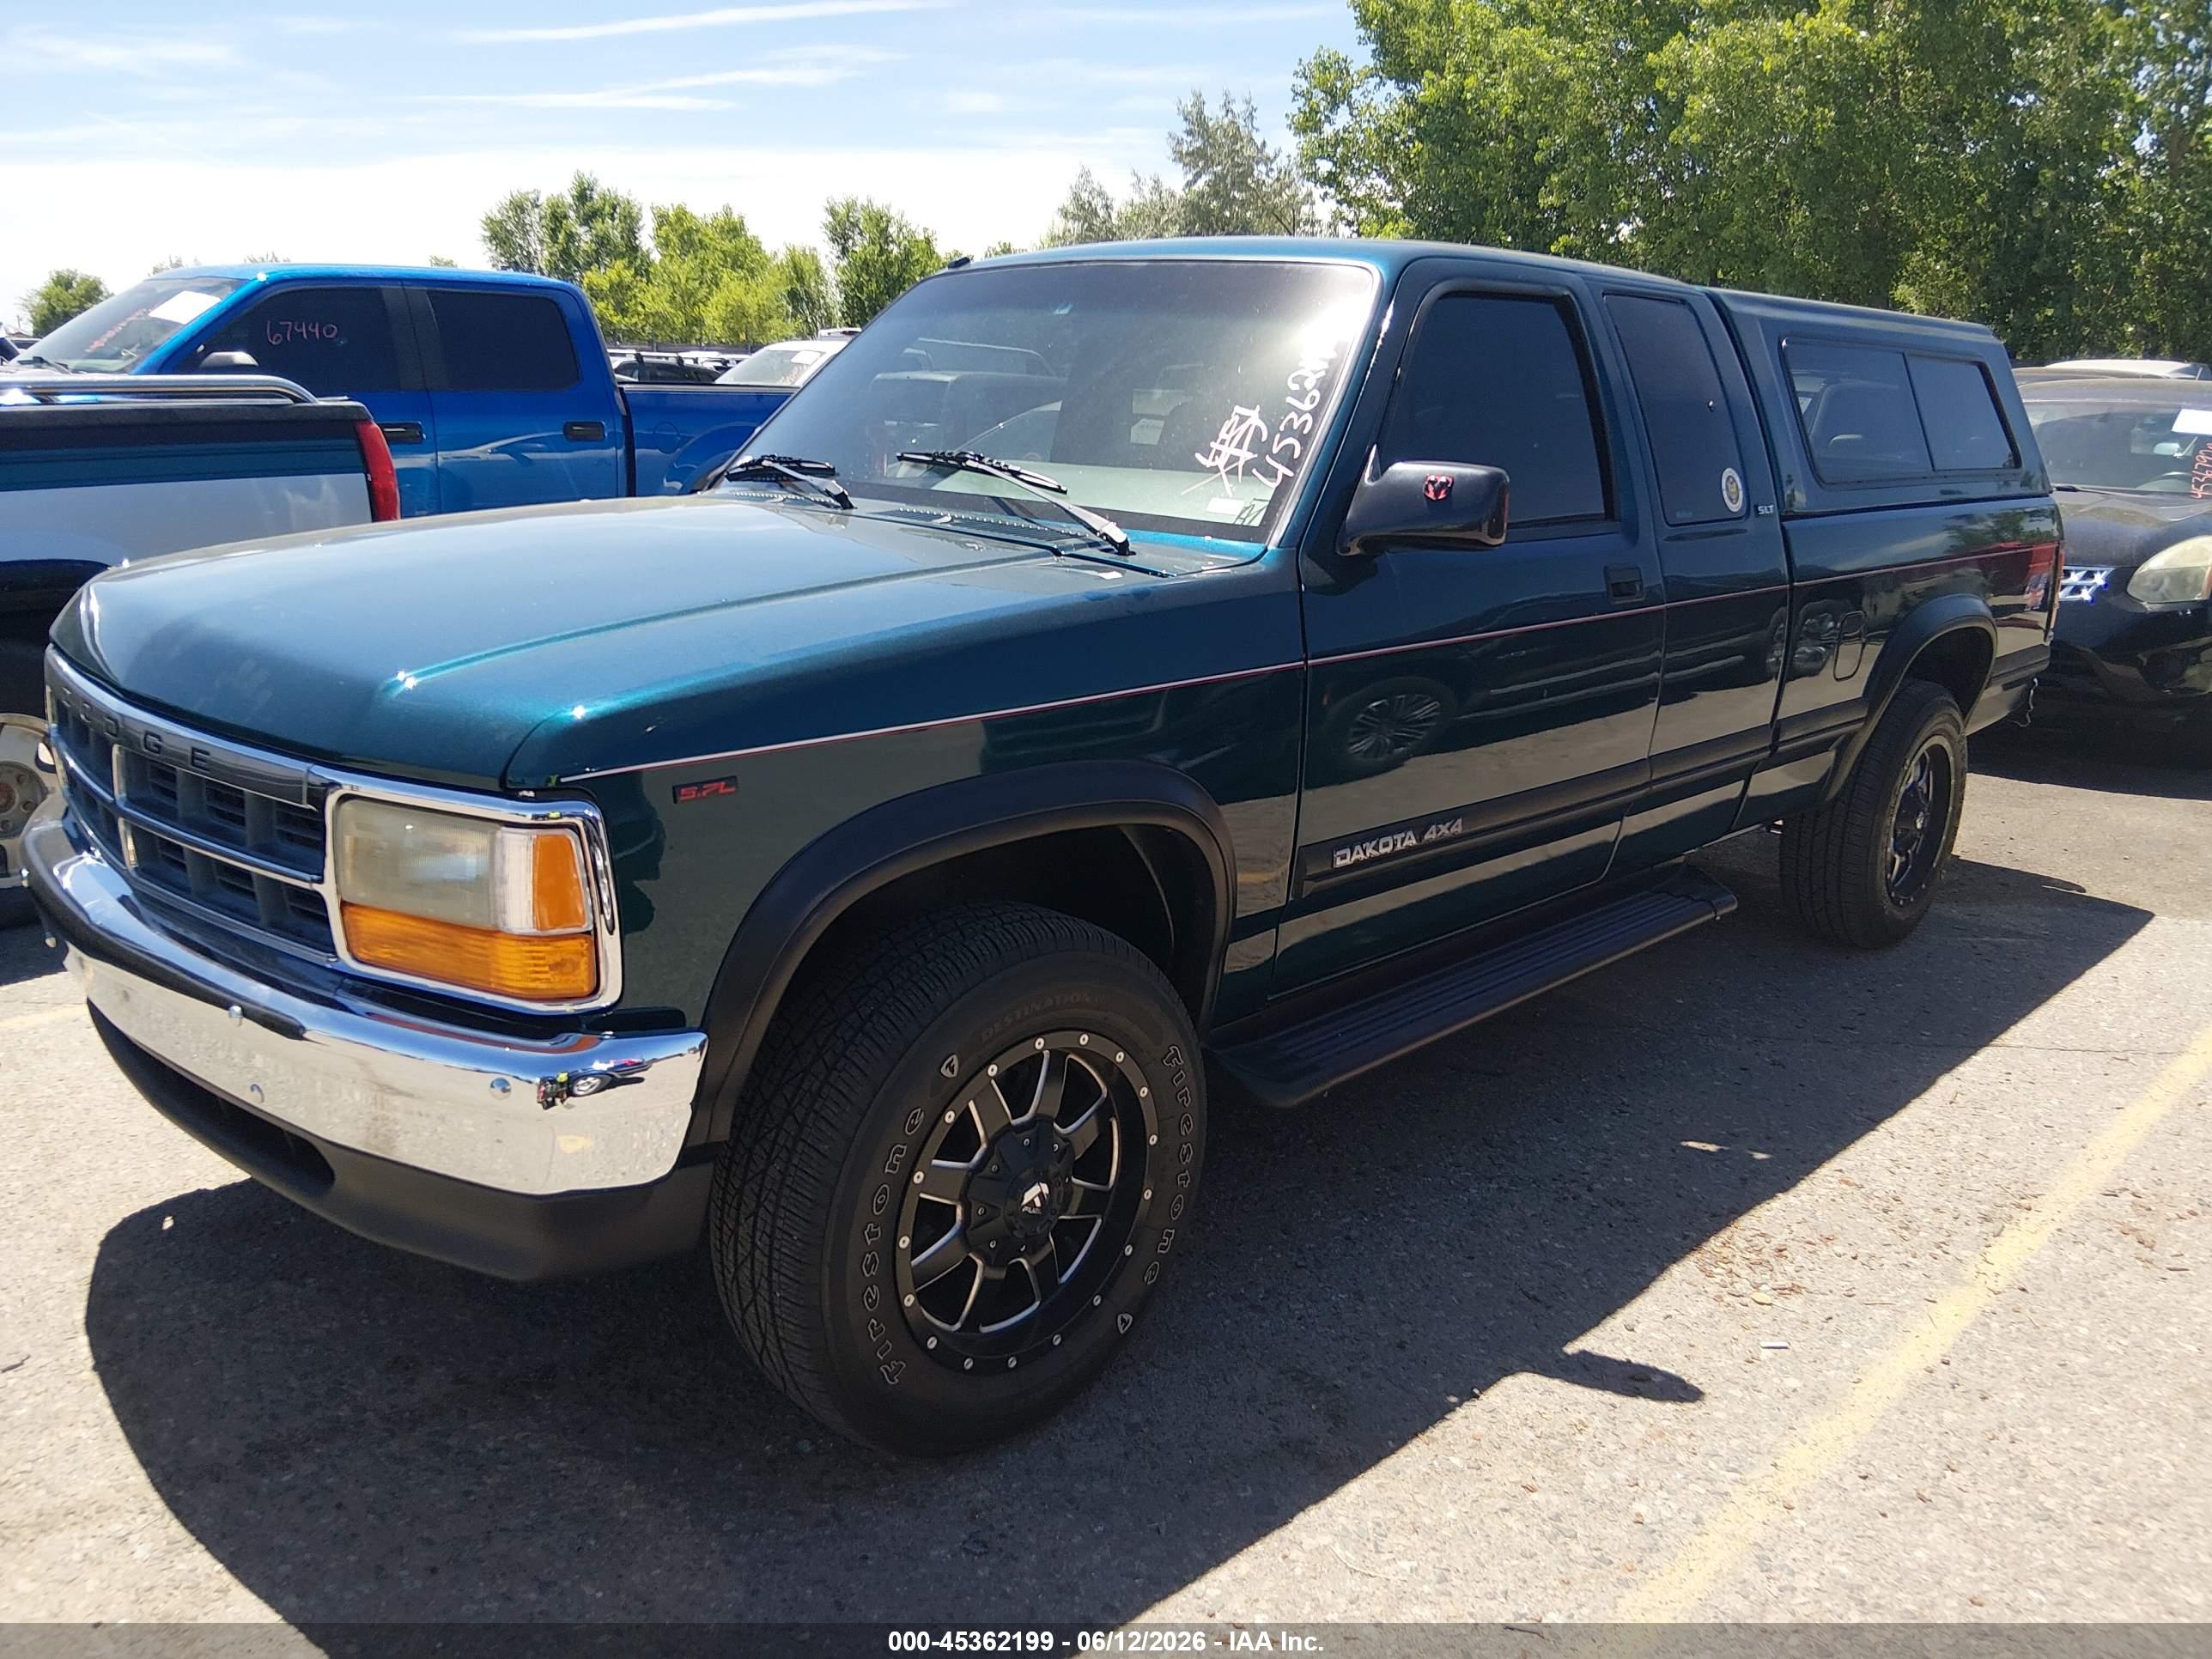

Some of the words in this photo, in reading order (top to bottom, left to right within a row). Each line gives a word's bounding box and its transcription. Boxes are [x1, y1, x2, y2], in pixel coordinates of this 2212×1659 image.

[266, 320, 337, 345] 67440
[1758, 505, 1774, 515] SLT
[1334, 830, 1418, 868] DAKOTA
[862, 1108, 924, 1384] Firestone
